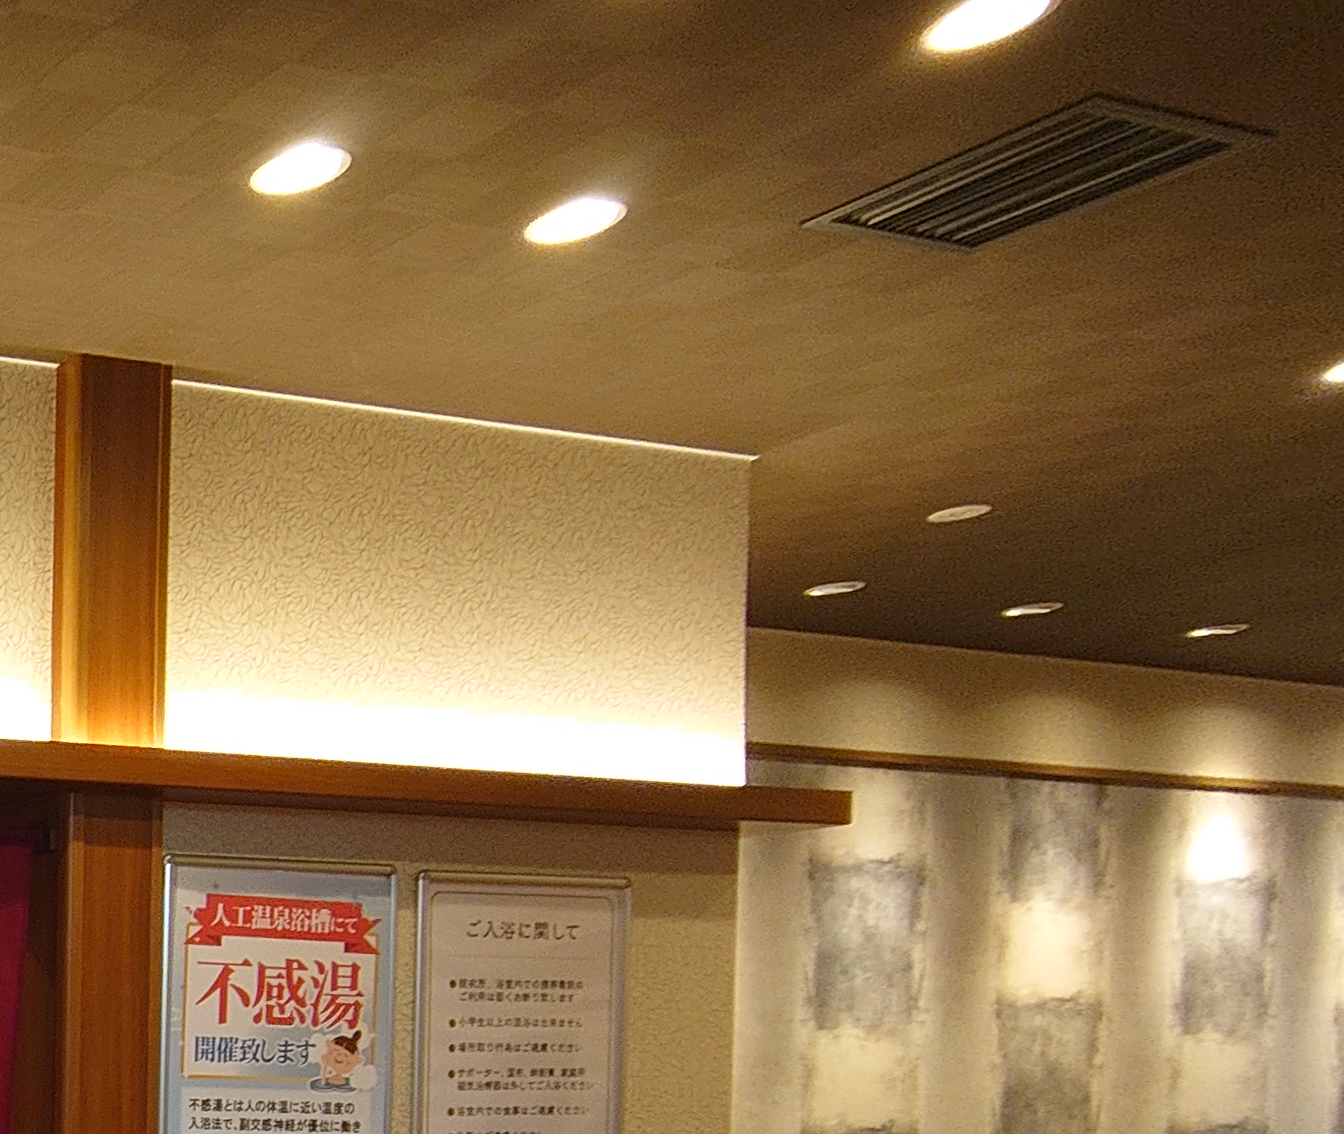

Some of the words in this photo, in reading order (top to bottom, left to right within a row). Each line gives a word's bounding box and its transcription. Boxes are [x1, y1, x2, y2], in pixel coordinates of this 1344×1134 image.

[211, 903, 359, 934] 人工温泉浴槽にて
[466, 919, 580, 940] ご入浴に関して
[195, 957, 364, 1030] 不感湯
[193, 1035, 316, 1066] 開催致します
[188, 1098, 356, 1116] 不感湯とは人の体温に近い温度の
[188, 1116, 363, 1134] 入浴法で、副交感神経が優位に働き
